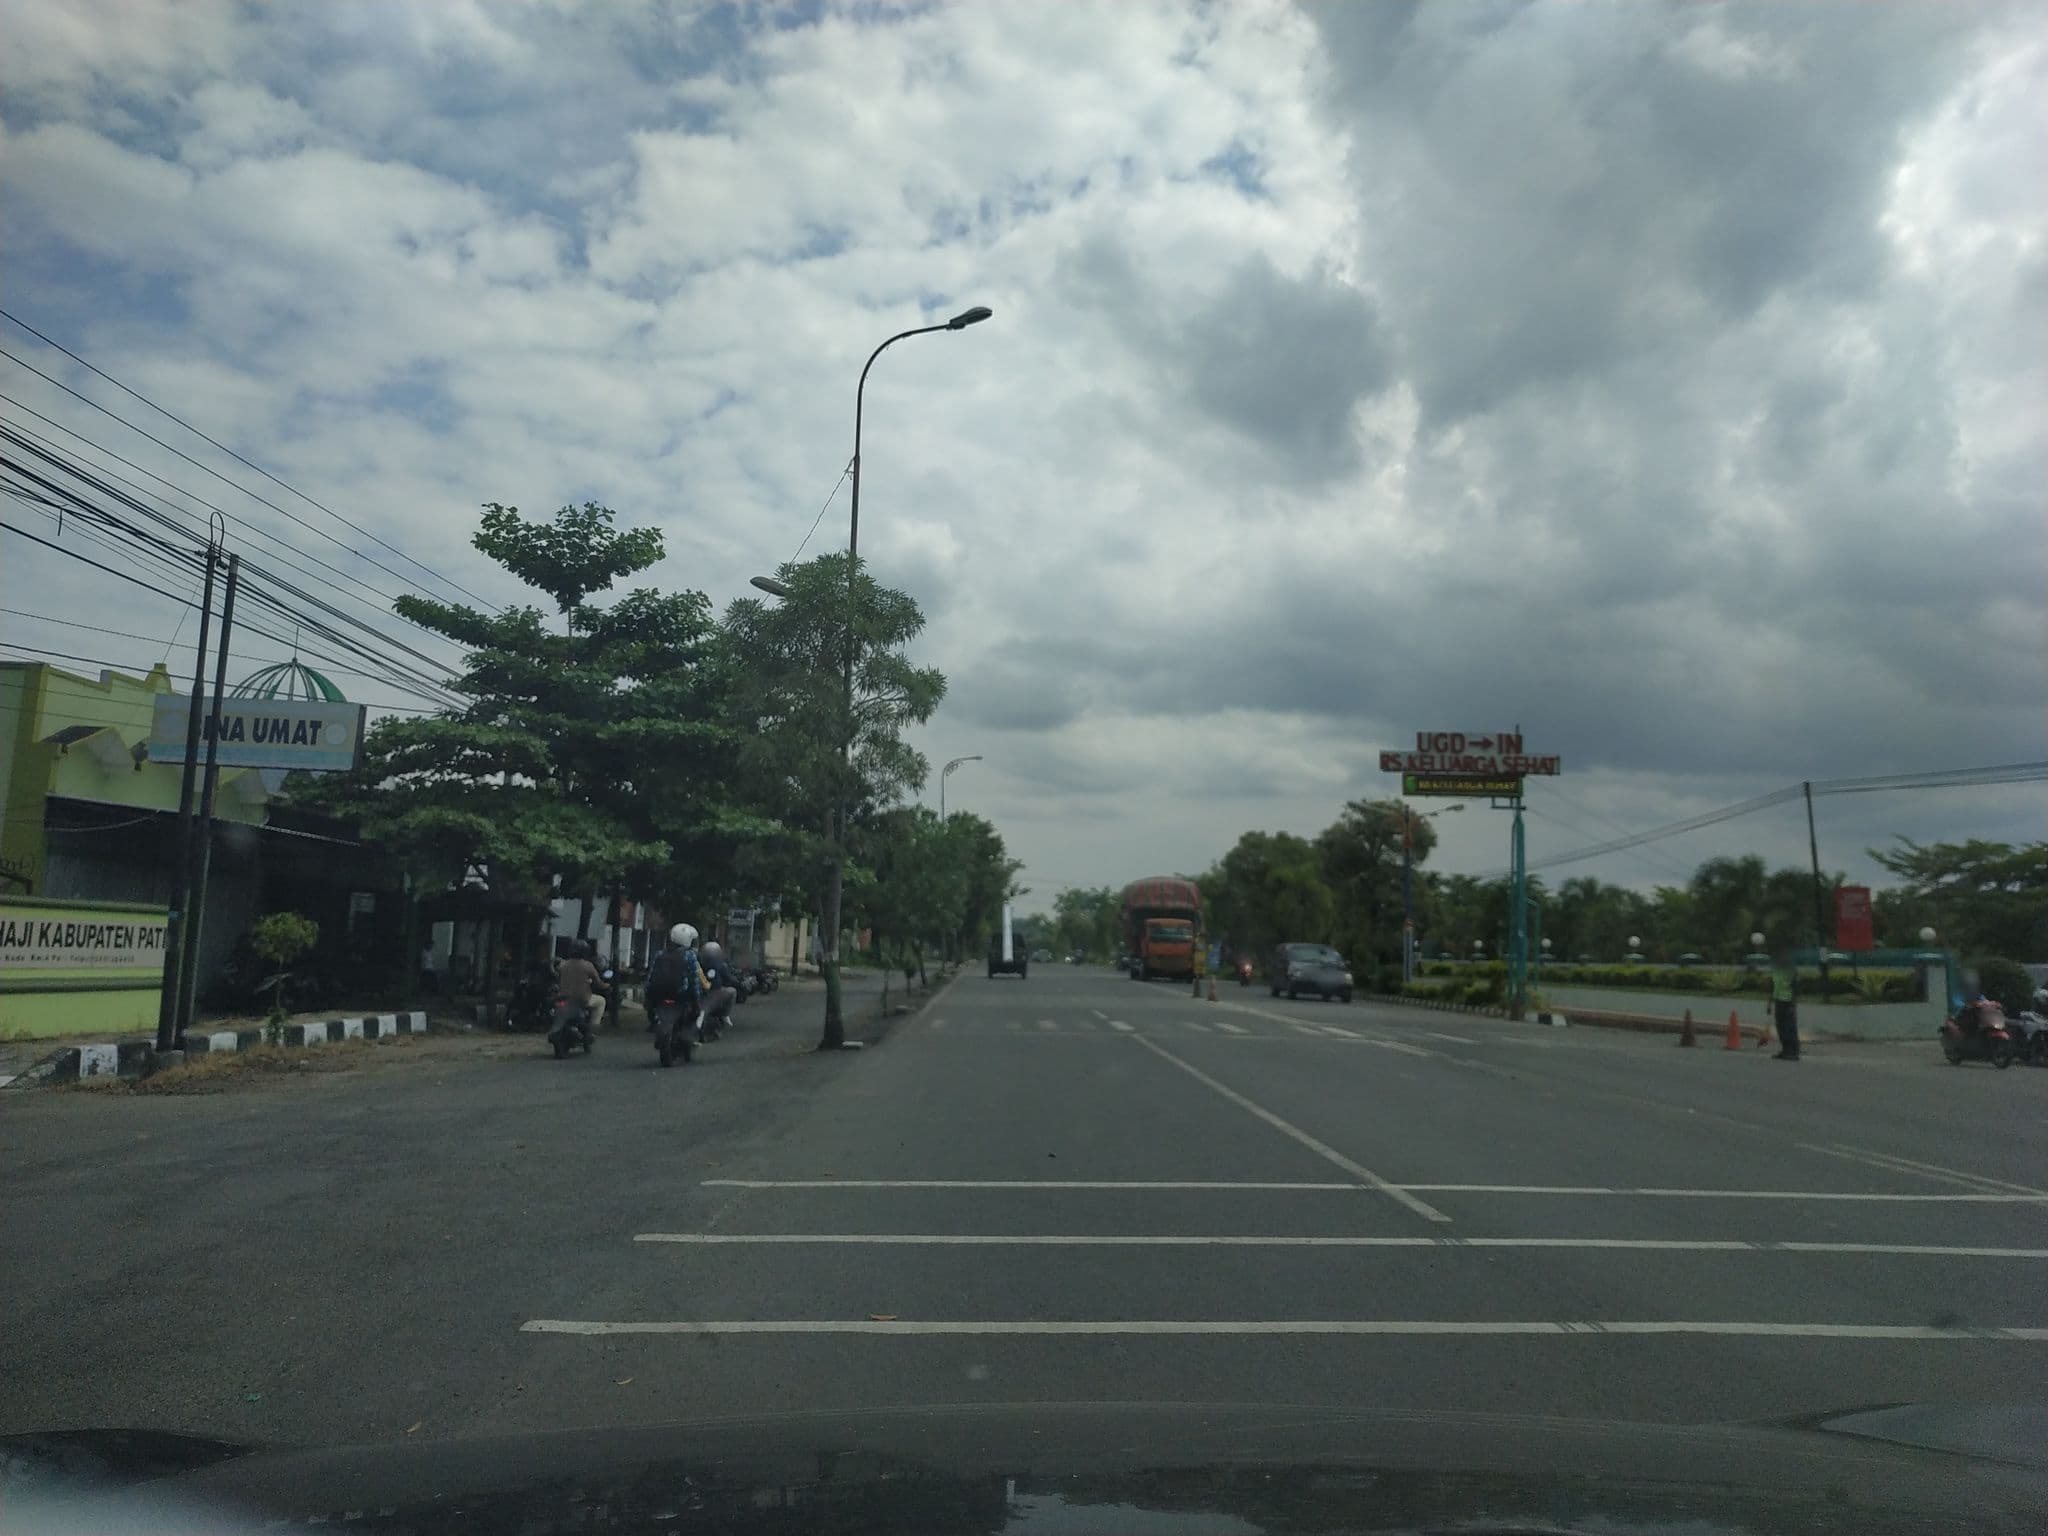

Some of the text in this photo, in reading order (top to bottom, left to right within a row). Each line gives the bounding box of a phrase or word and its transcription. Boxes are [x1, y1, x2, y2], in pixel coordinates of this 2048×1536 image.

[252, 716, 322, 746] UMAT
[1416, 732, 1522, 755] UGD IN
[38, 921, 134, 949] KABUPATEN
